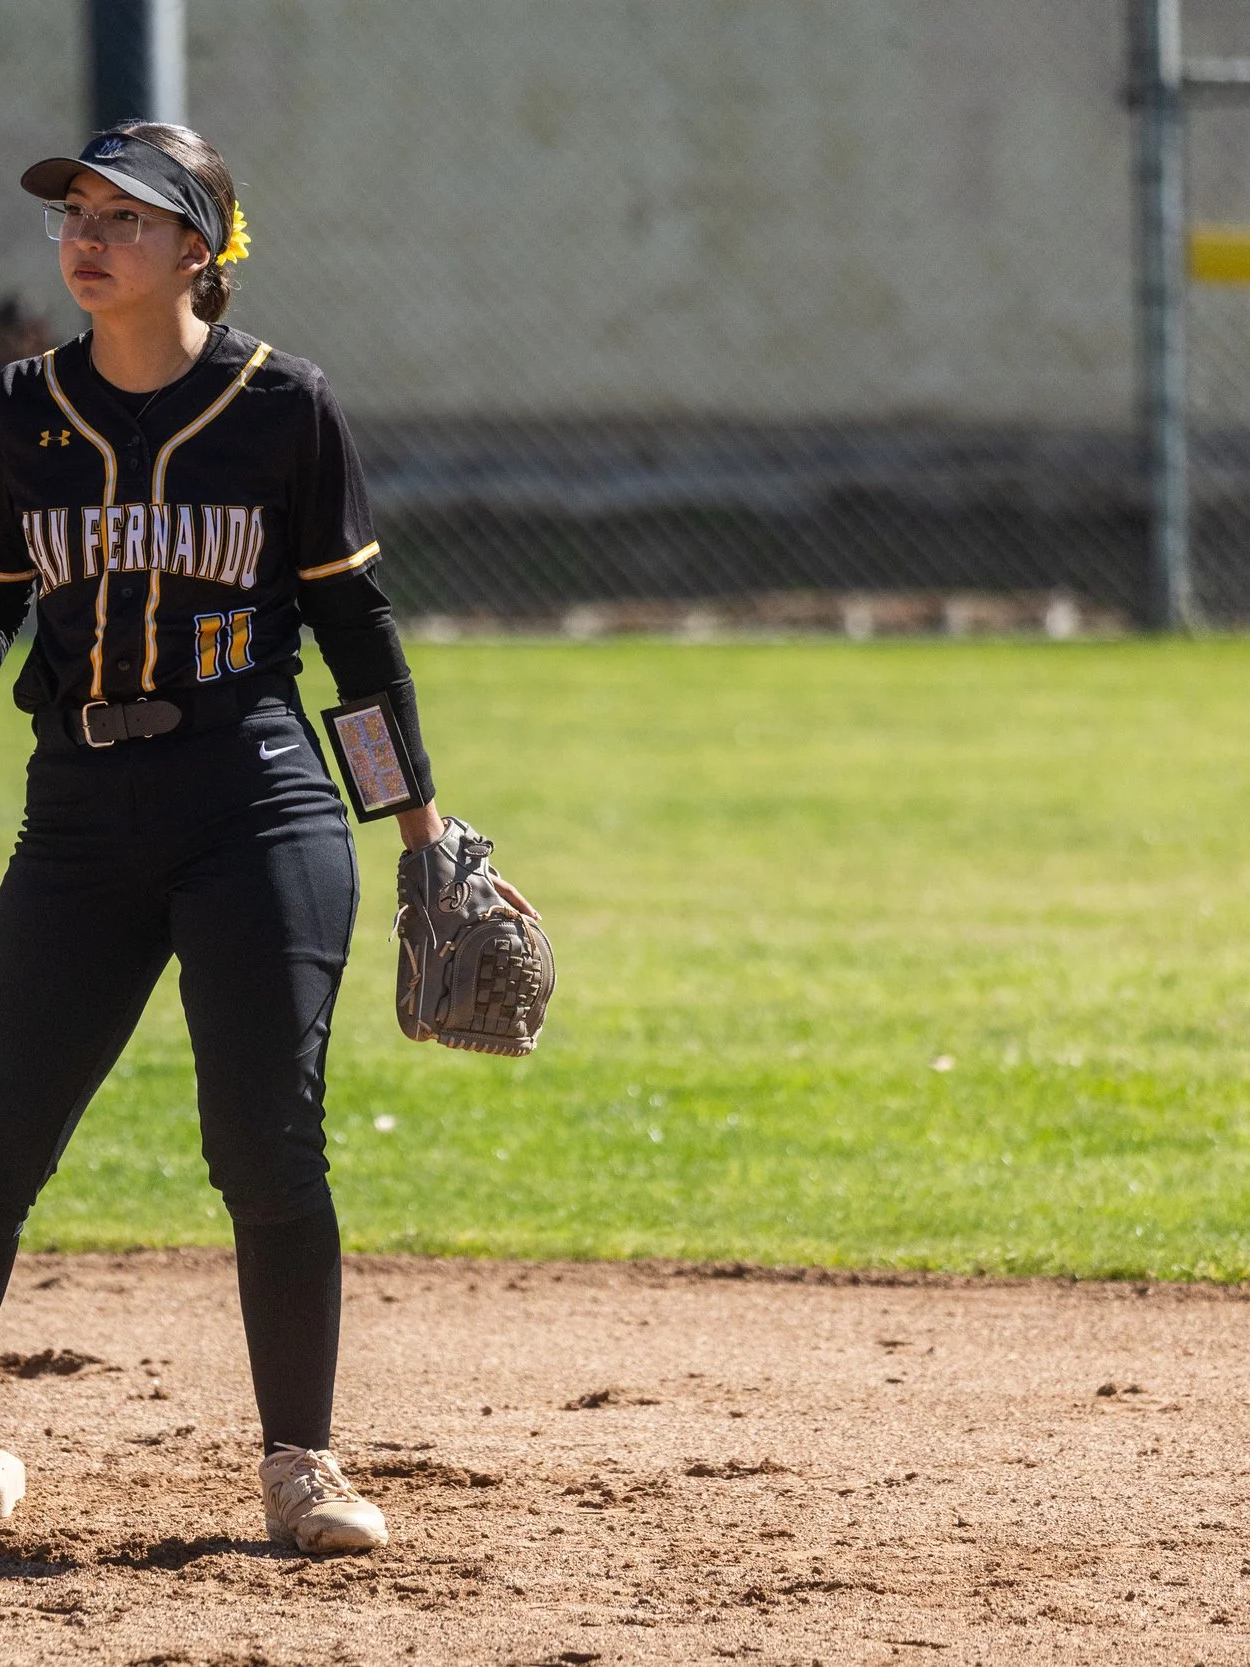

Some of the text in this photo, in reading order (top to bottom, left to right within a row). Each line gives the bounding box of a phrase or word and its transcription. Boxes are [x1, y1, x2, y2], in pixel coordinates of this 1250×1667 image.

[22, 503, 264, 599] AN FERNANDO
[194, 607, 256, 682] 11
